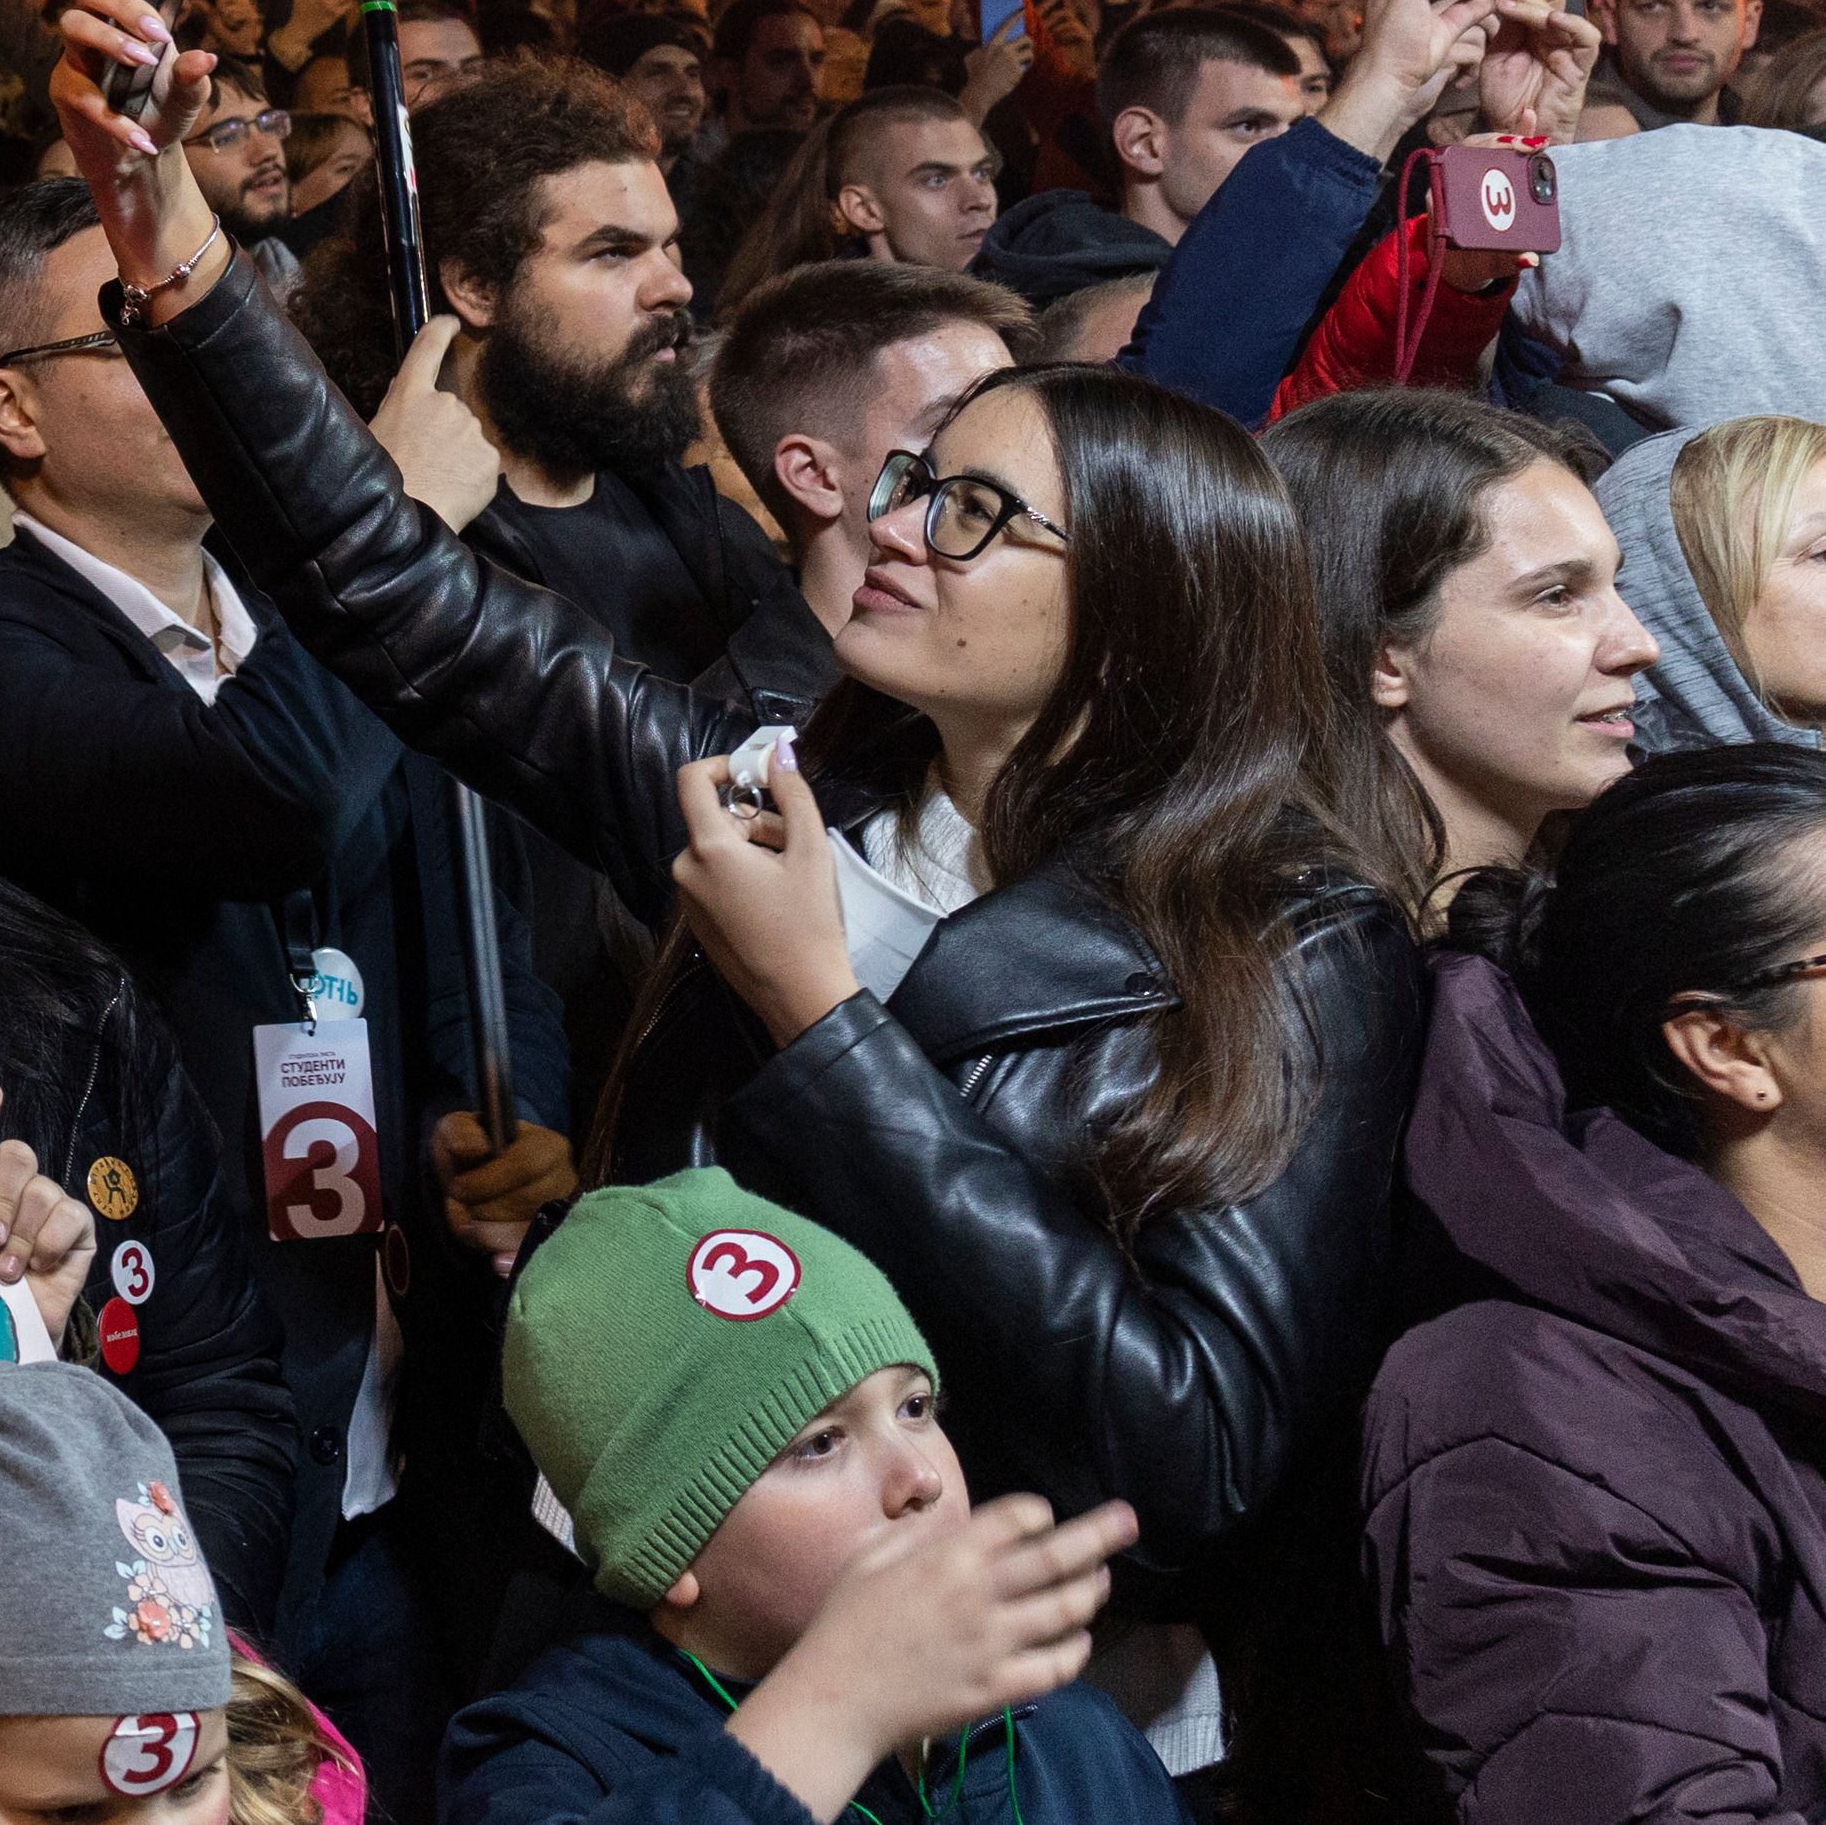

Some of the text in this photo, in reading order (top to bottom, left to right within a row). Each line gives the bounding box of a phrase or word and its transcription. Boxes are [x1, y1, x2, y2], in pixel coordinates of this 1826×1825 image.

[280, 1059, 346, 1074] СТУДЕНТИ
[281, 1073, 346, 1088] ПОБЕЂУЈУ
[283, 1118, 366, 1239] 3
[121, 1247, 149, 1297] 3
[701, 1241, 780, 1305] 3
[122, 1712, 178, 1785] 3
